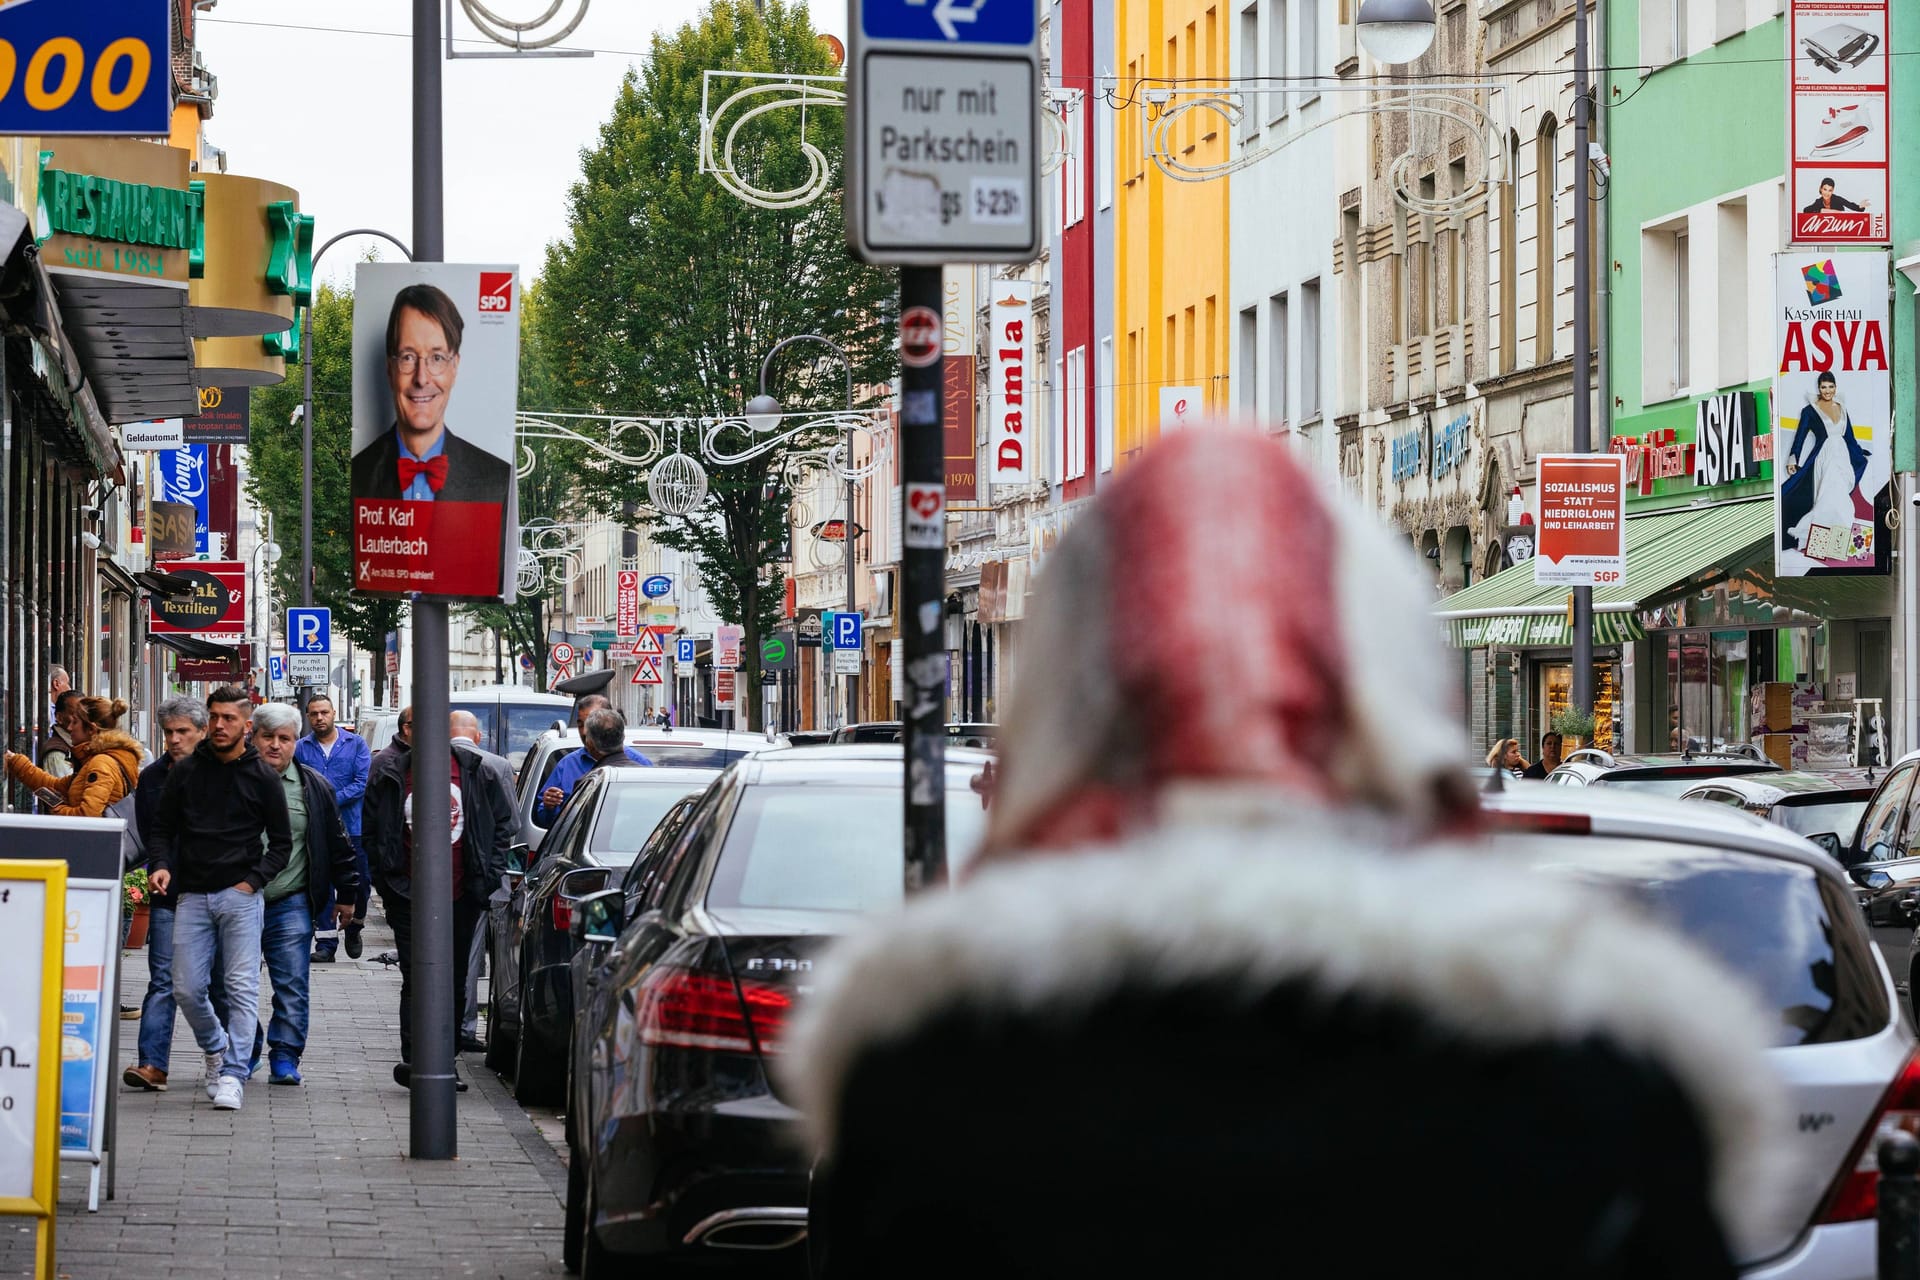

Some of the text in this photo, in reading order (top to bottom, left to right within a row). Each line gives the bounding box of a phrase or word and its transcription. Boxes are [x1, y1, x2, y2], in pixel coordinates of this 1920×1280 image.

[0, 37, 152, 112] 00
[902, 81, 998, 116] nur mit
[880, 125, 1019, 164] Parkschein
[54, 168, 201, 250] RESTAURANT
[1802, 215, 1863, 236] arzum
[63, 244, 165, 277] seit 1984
[480, 295, 507, 310] SPD
[1780, 320, 1889, 373] ASYA
[997, 319, 1024, 473] Damla
[126, 433, 179, 443] Geldautomat
[1693, 391, 1746, 487] ASYA
[950, 472, 975, 487] 1970
[1544, 483, 1616, 493] SOZIALISMUS
[1563, 496, 1594, 506] STATT
[359, 505, 415, 527] Prof. Karl
[1544, 509, 1616, 519] NIEDRIGLOHN
[1544, 521, 1616, 530] UND LEIHARBEIT
[359, 533, 429, 556] Lauterbach
[1593, 571, 1620, 582] SGP
[647, 584, 670, 592] EFES
[162, 600, 218, 615] Textilien
[619, 589, 628, 635] TURKISH
[627, 589, 637, 635] AIRLINES
[557, 648, 570, 659] 30
